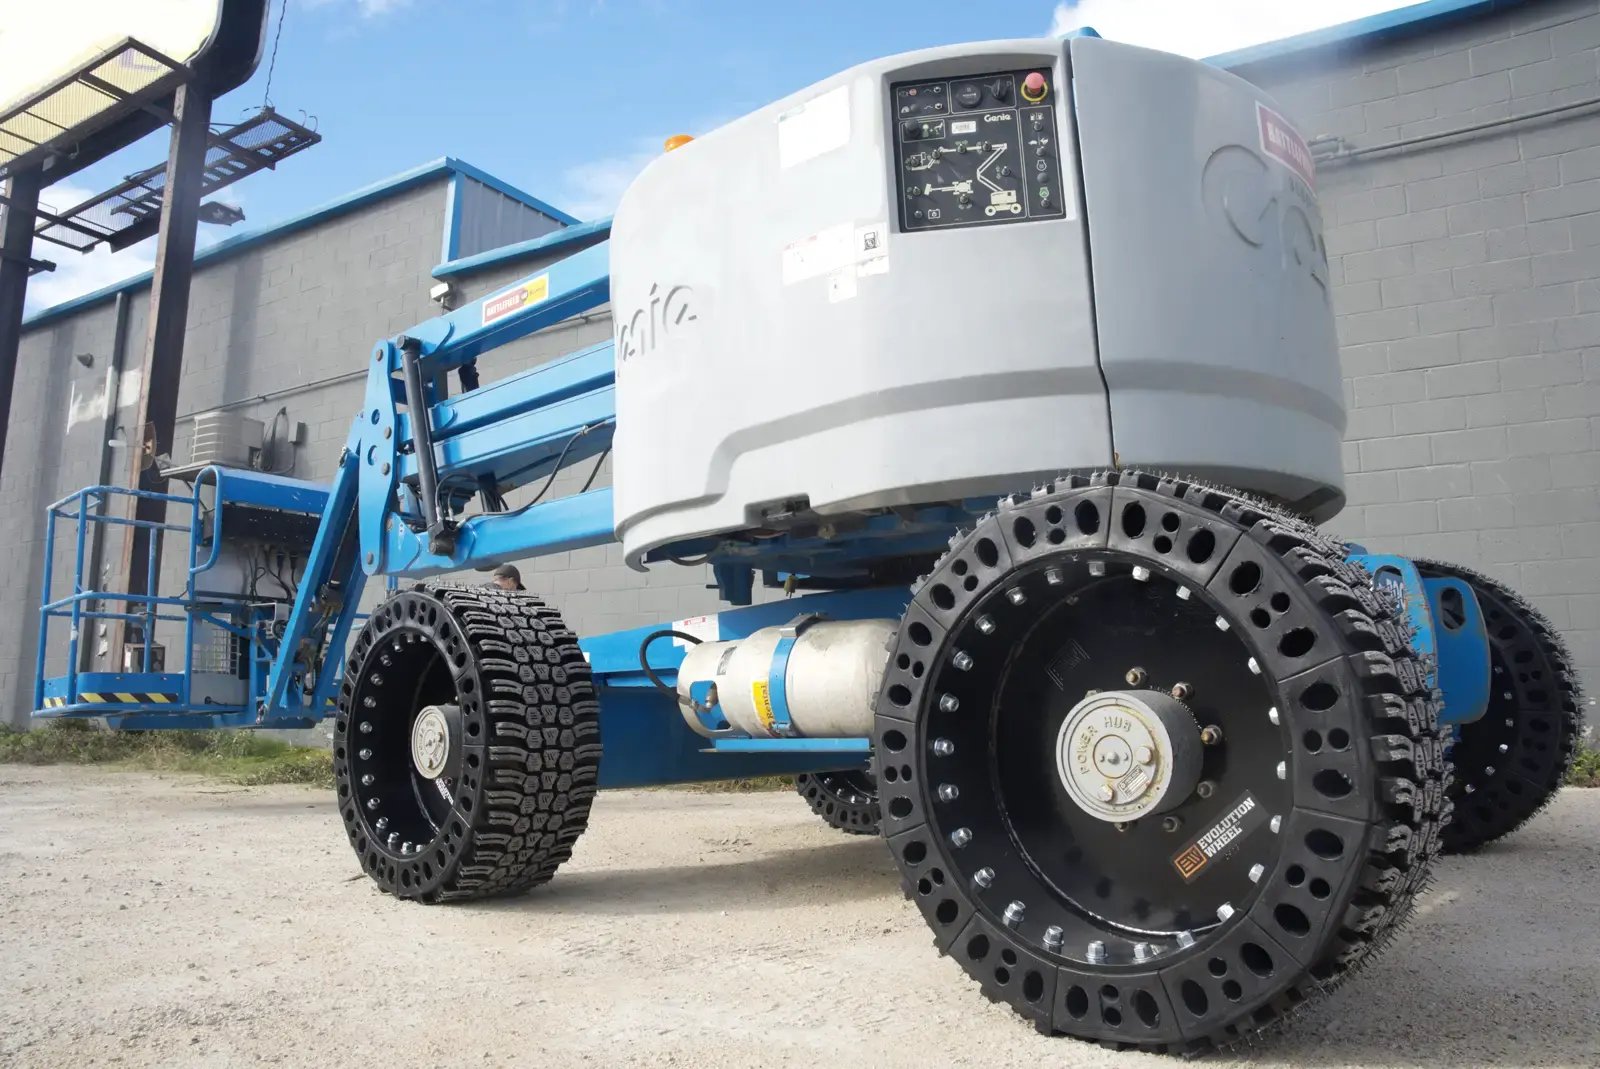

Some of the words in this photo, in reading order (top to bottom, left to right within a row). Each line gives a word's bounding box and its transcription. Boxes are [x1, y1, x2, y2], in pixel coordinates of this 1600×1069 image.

[984, 113, 1012, 123] Genie
[1076, 725, 1098, 775] POWER
[1103, 716, 1132, 733] HUB
[1196, 797, 1256, 850] EVOLUTION
[1203, 825, 1243, 858] WHEEL
